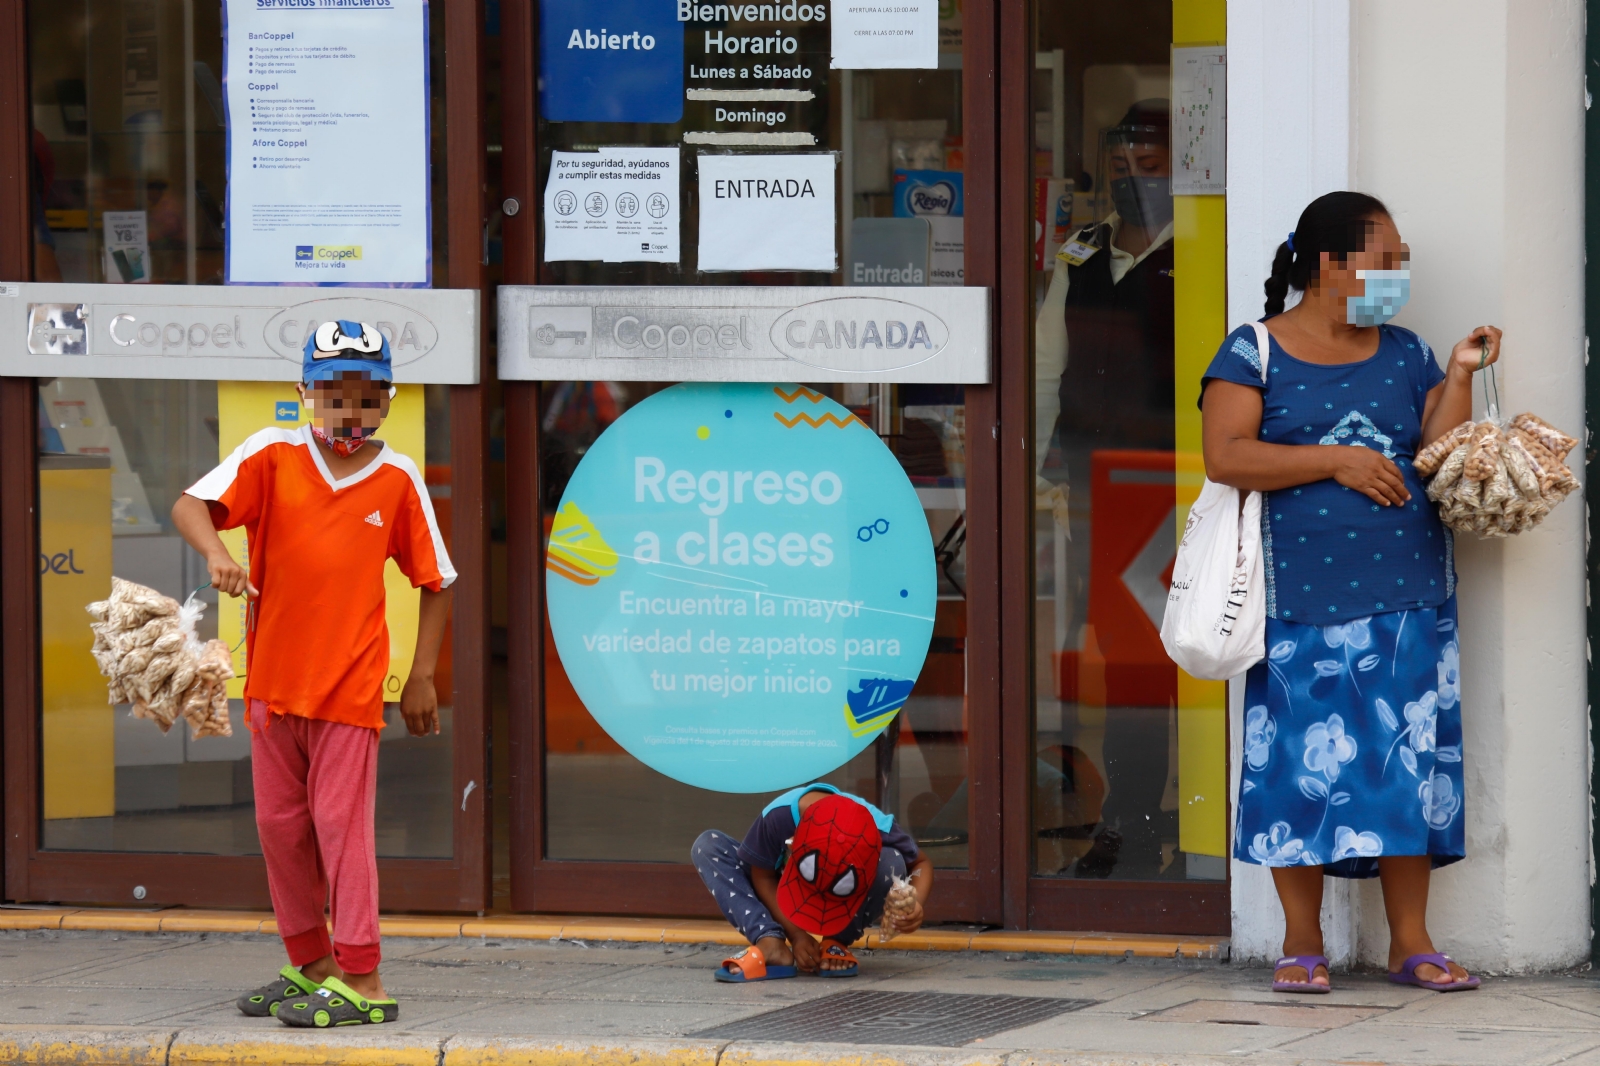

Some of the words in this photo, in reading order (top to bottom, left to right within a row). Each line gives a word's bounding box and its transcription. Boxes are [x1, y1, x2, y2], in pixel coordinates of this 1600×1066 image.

[677, 0, 826, 22] Bienvenidos
[248, 32, 294, 42] BanCoppel
[567, 28, 656, 50] Abierto
[705, 30, 798, 54] Horario
[690, 64, 736, 79] Lunes
[740, 68, 748, 79] a
[753, 64, 812, 79] Sábado
[248, 82, 278, 92] Coppel
[715, 108, 786, 126] Domingo
[252, 139, 276, 147] Afore
[277, 139, 308, 148] Coppel
[556, 160, 570, 168] Por
[581, 158, 626, 170] seguridad,
[628, 159, 670, 170] ayúdanos
[565, 170, 598, 181] cumplir
[599, 171, 622, 180] estas
[624, 170, 661, 180] medidas
[715, 179, 815, 198] ENTRADA
[318, 248, 358, 260] Coppel
[294, 261, 320, 270] Mejora
[854, 262, 923, 283] Entrada
[110, 312, 246, 356] Coppel
[613, 314, 753, 357] Coppel
[785, 320, 933, 350] CANADA
[635, 456, 843, 516] Regreso
[633, 529, 660, 565] a
[676, 518, 834, 566] clases
[620, 591, 747, 616] Encuentra
[756, 592, 775, 616] la
[784, 600, 863, 623] mayor
[582, 628, 691, 654] variedad
[699, 630, 731, 654] de
[738, 633, 836, 660] zapatos
[844, 638, 900, 660] para
[650, 670, 676, 691] tu
[684, 668, 758, 698] mejor
[764, 668, 832, 693] inicio
[728, 727, 758, 736] premios
[770, 727, 816, 736] Coppel.com
[643, 736, 675, 745] Vigencia
[706, 738, 730, 747] agosto
[763, 739, 804, 748] septiembre
